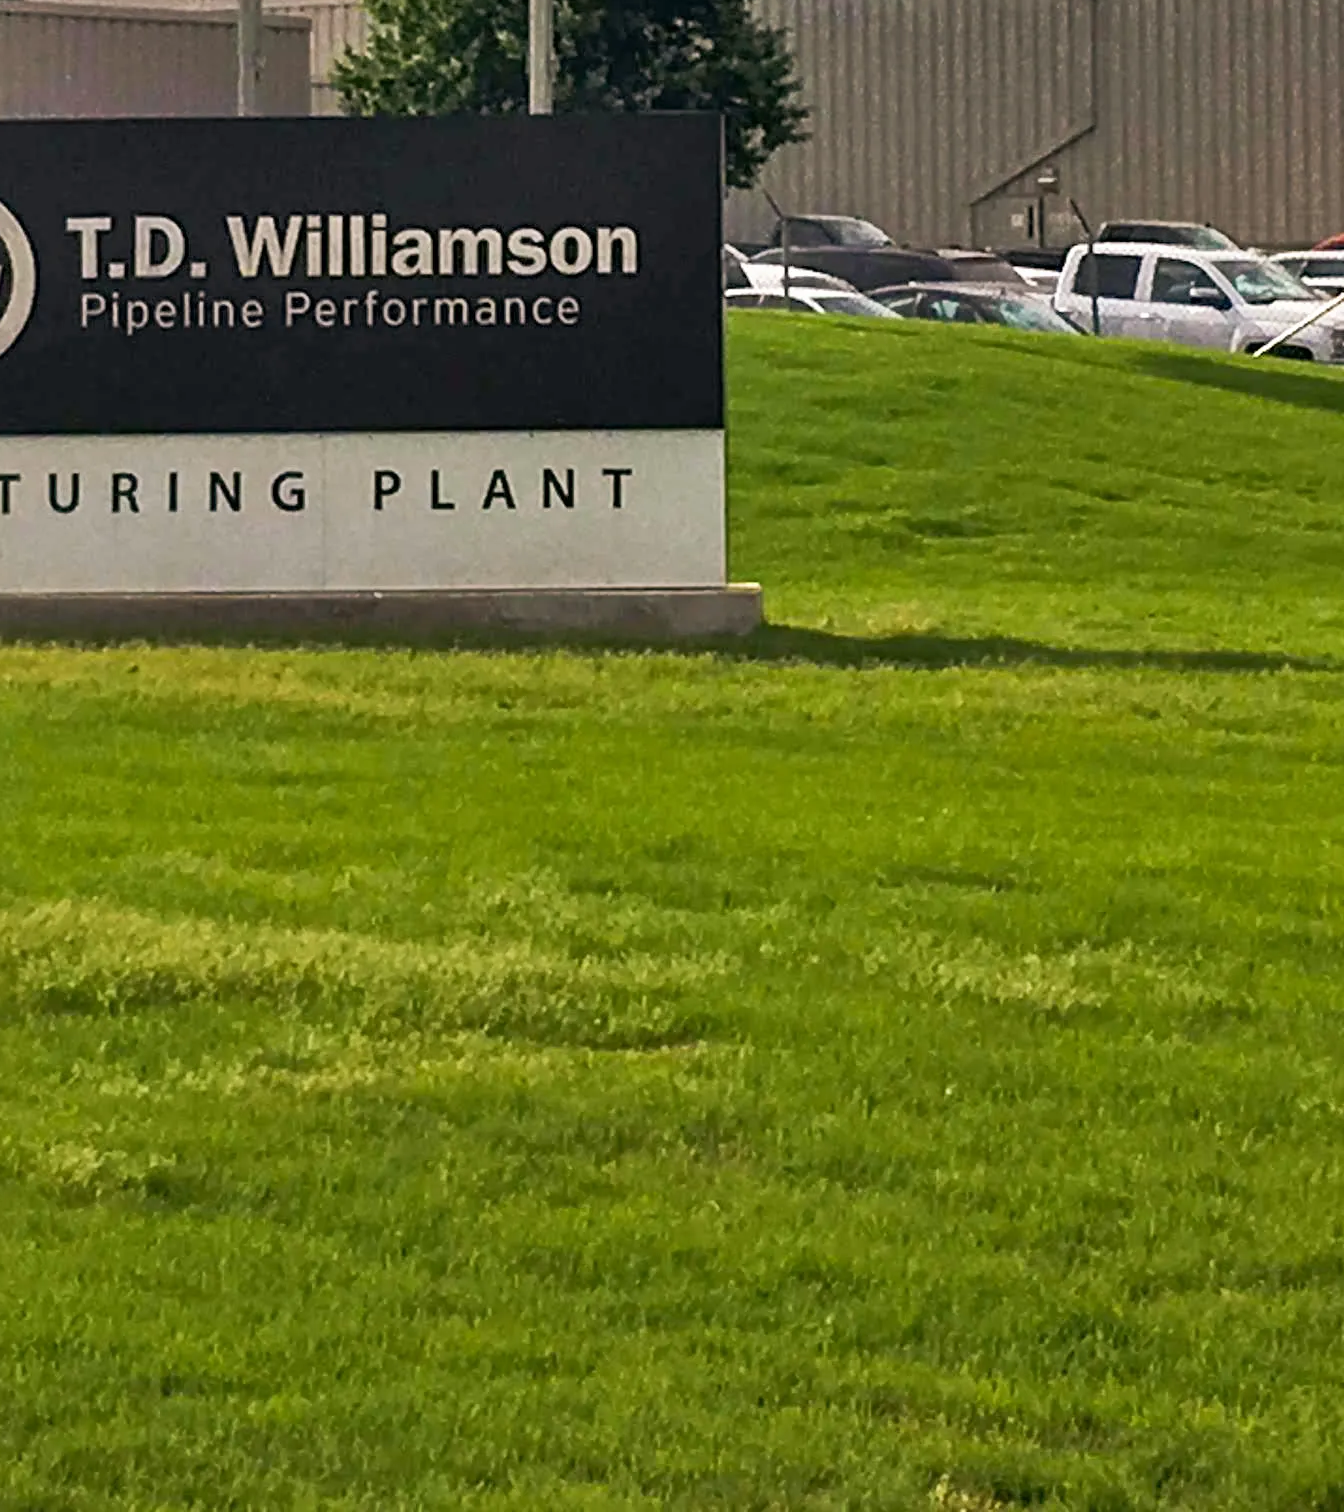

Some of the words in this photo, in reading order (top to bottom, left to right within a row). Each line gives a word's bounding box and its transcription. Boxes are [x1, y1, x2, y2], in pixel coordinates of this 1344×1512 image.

[66, 216, 207, 279] T.D.
[226, 213, 638, 278] Williamson
[81, 291, 264, 336] Pipeline
[285, 289, 580, 327] Performance
[373, 468, 634, 511] PLANT
